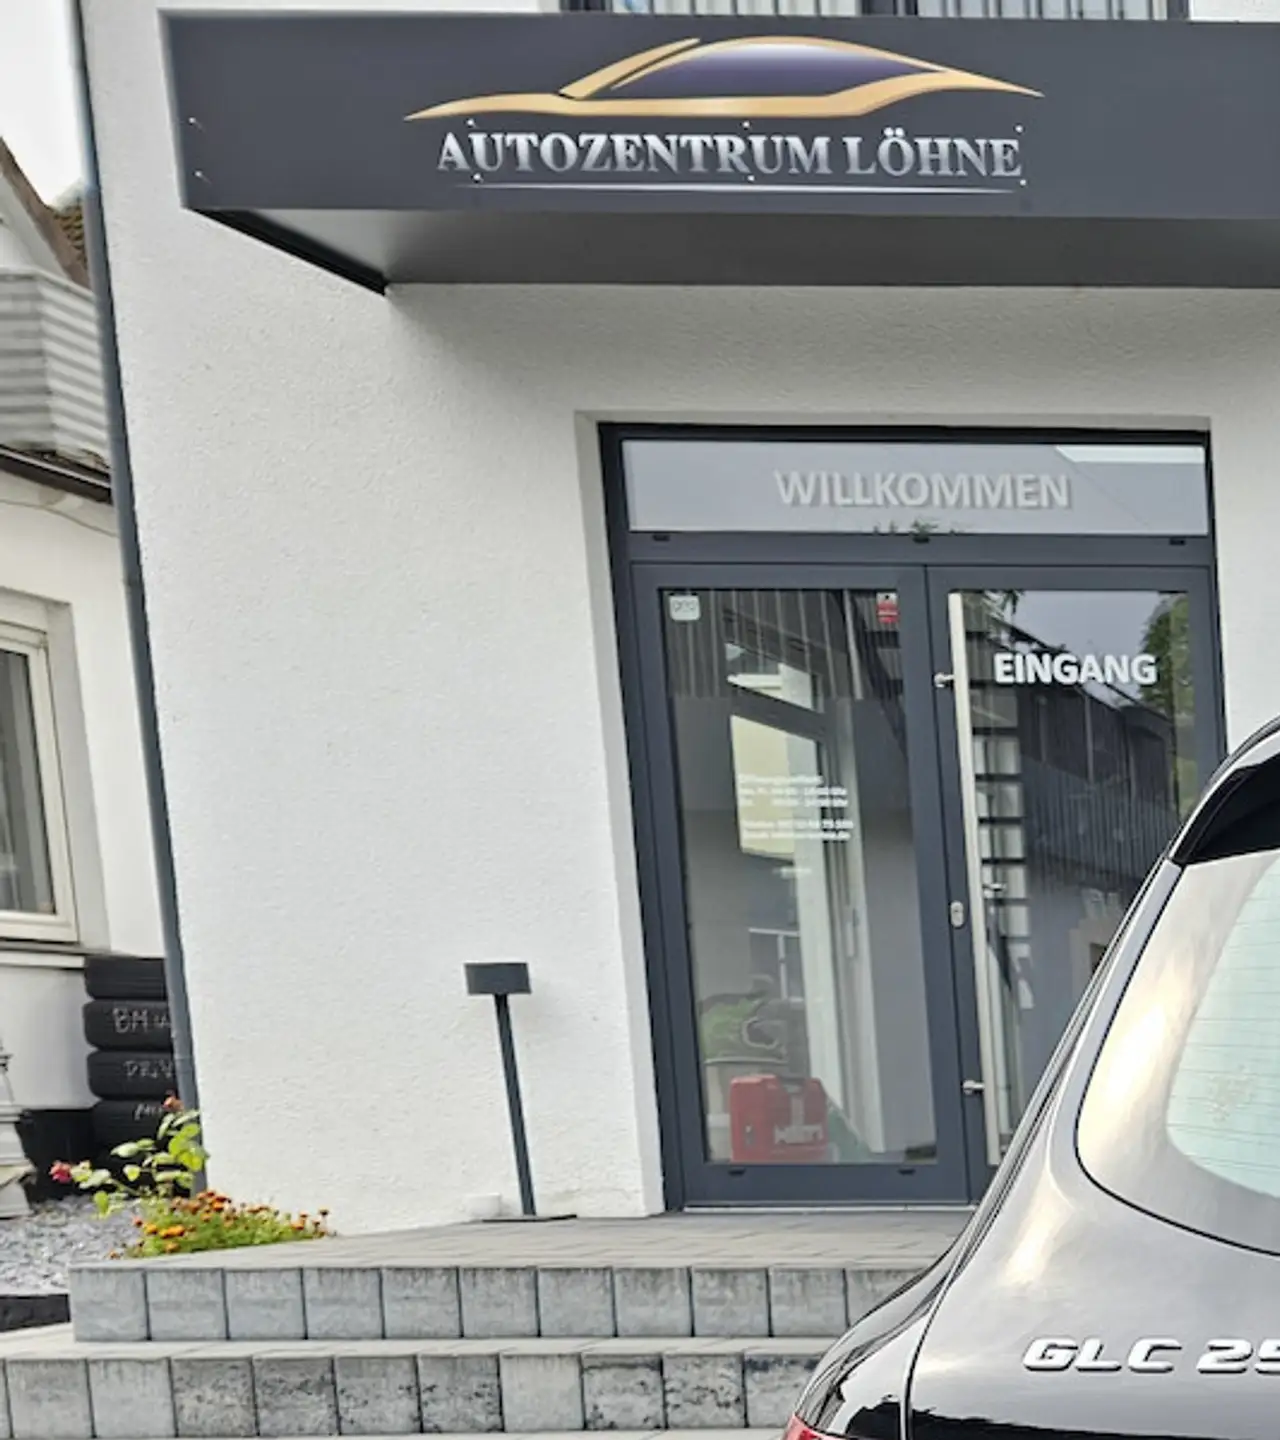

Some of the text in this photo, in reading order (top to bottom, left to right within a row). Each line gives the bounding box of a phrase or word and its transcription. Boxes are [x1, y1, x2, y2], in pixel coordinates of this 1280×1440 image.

[436, 127, 1024, 178] AUTOZENTRUM LÖHNE
[774, 469, 1073, 509] WILLKOMMEN
[993, 652, 1158, 685] EINGANG
[1022, 1337, 1182, 1372] GLC
